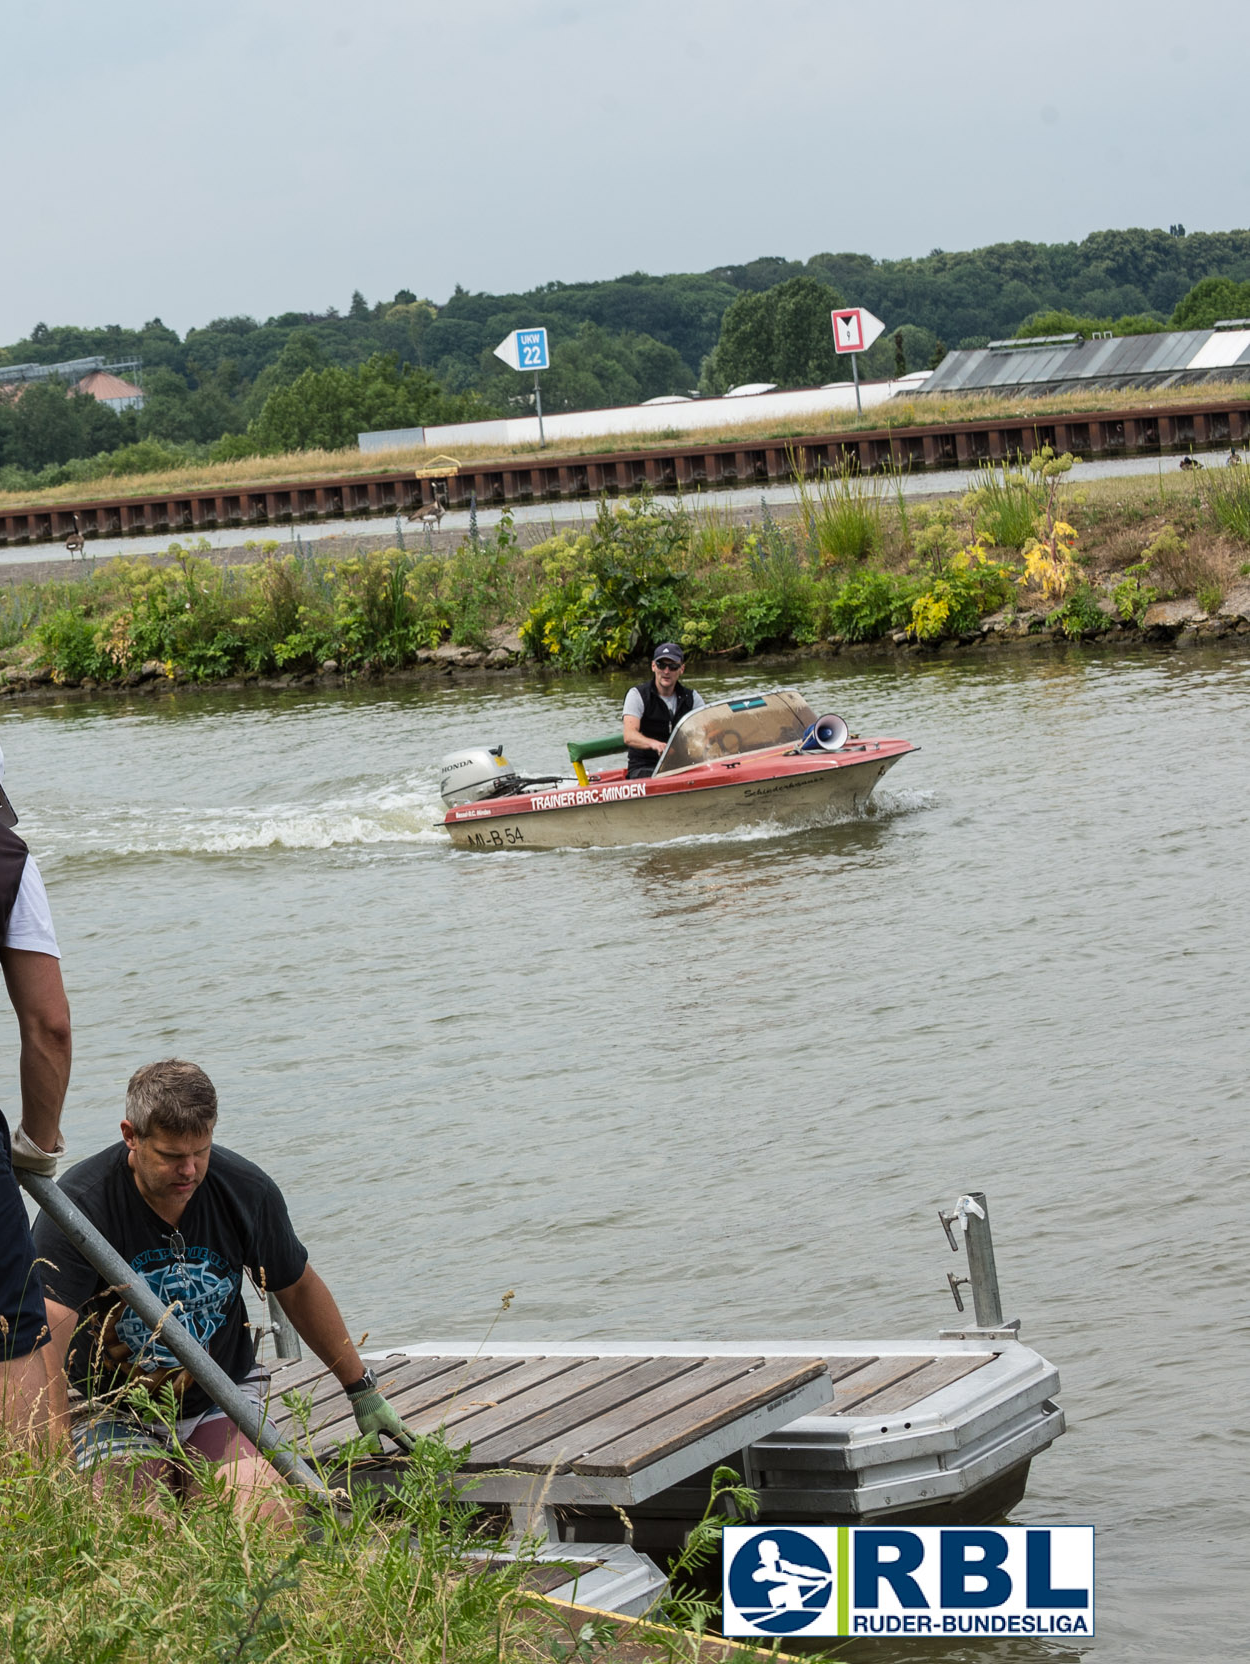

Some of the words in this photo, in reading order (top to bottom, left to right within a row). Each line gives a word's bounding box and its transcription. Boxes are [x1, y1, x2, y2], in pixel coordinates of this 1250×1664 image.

[521, 333, 540, 345] UKW
[846, 330, 851, 342] 9
[523, 346, 541, 364] 22
[441, 759, 473, 774] HONDA
[530, 791, 576, 811] TRAINER
[505, 826, 524, 845] 54
